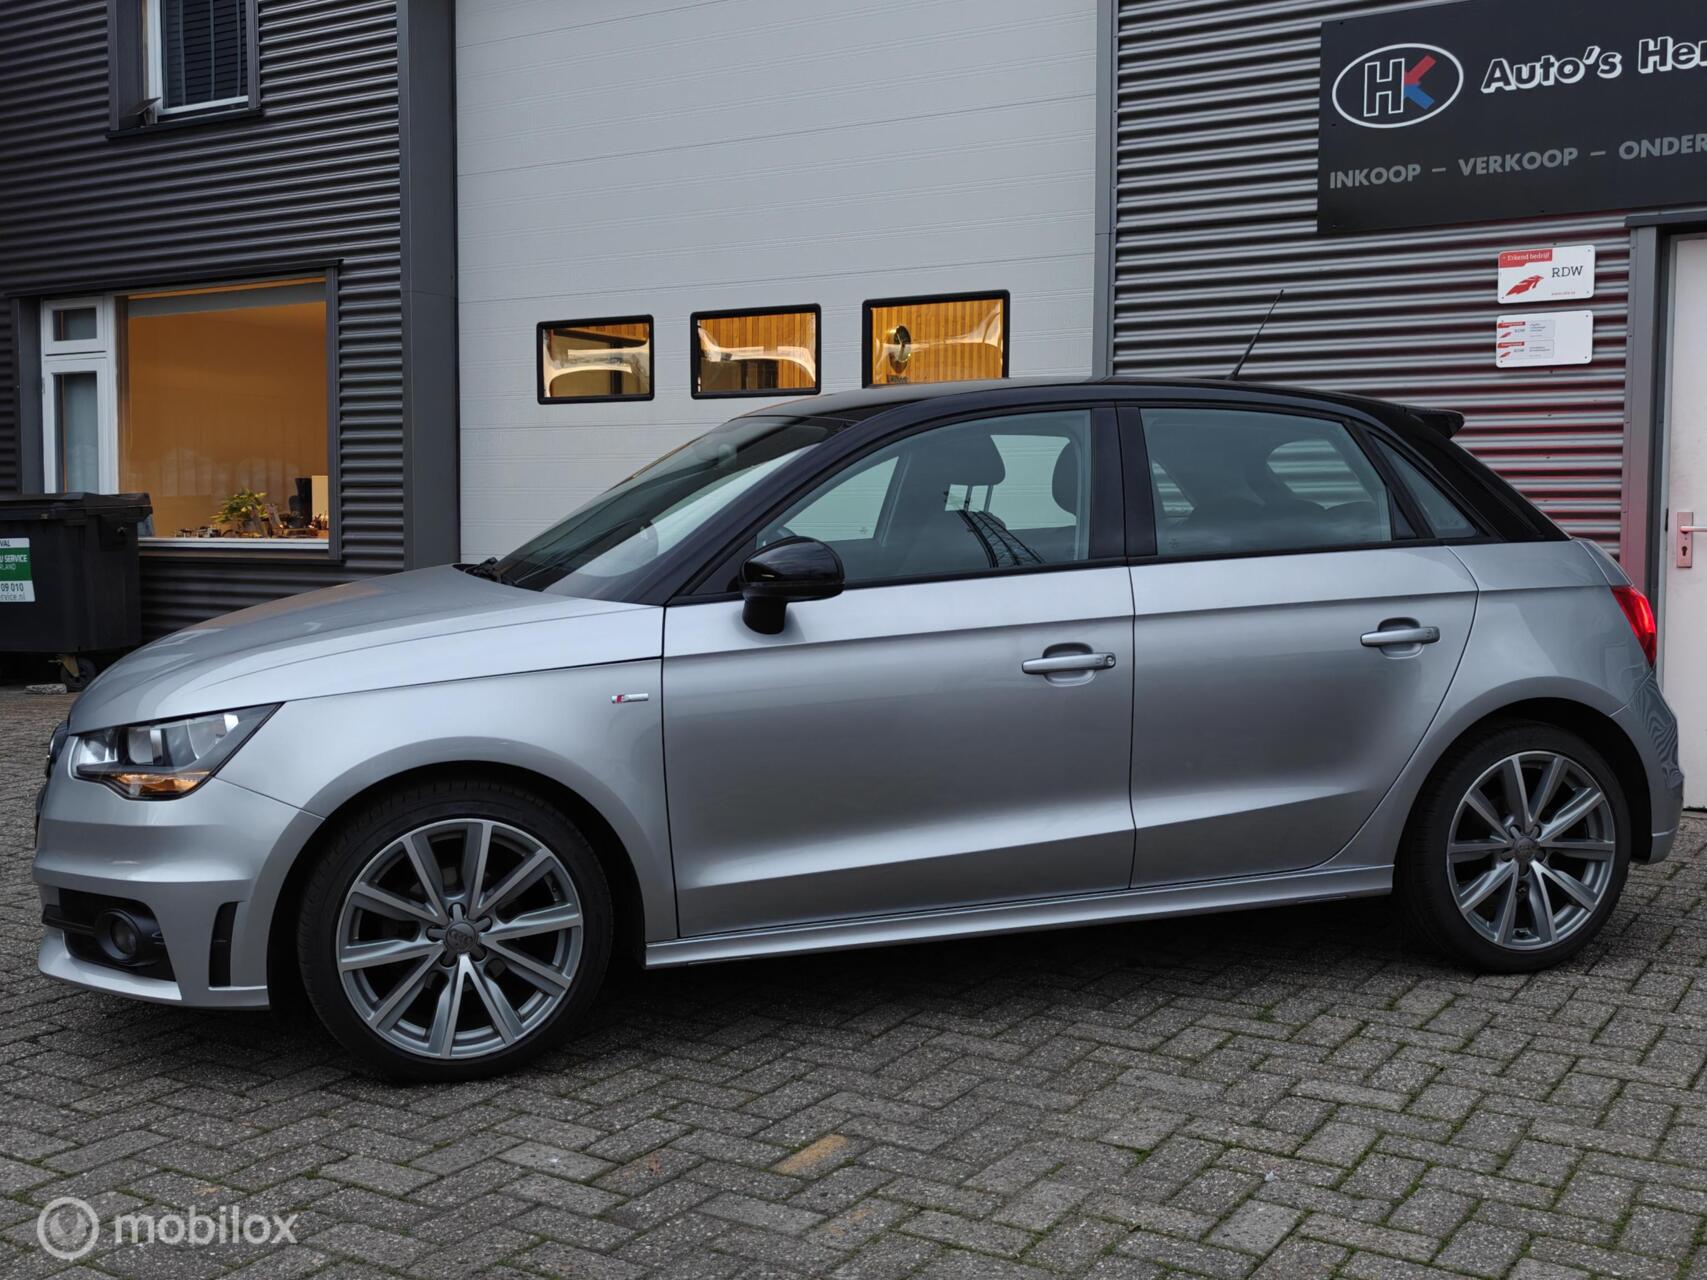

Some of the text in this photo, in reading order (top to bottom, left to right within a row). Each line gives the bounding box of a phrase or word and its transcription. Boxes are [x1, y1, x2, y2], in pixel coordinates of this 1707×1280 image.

[1481, 46, 1622, 93] Auto's
[1329, 163, 1422, 189] INKOOP
[1458, 147, 1579, 176] VERKOOP
[1552, 265, 1583, 277] RDW
[5, 554, 28, 562] SERVICE
[1, 582, 24, 592] 09 010
